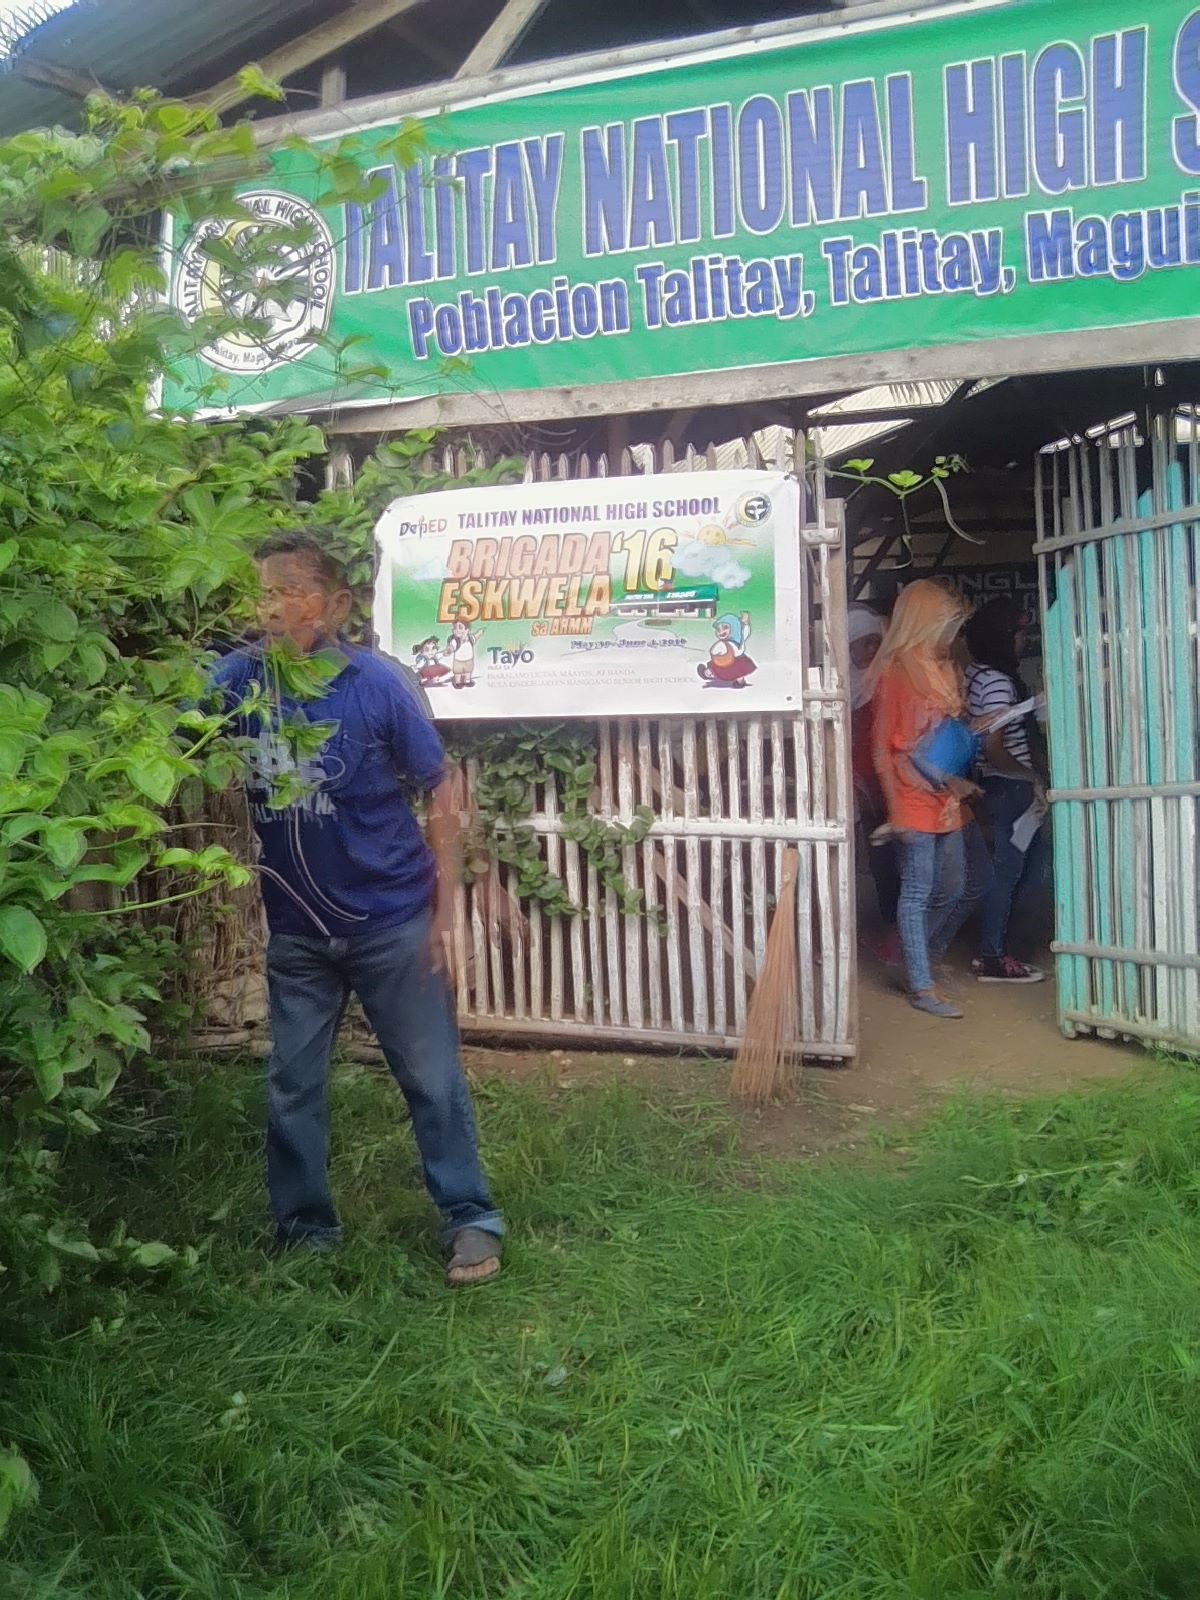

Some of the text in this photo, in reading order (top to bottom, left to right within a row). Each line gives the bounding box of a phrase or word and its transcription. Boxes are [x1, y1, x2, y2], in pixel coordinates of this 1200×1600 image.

[579, 71, 928, 259] NATIONAL
[944, 24, 1149, 206] HIGH
[406, 275, 632, 361] Poblacion
[635, 253, 815, 330] Talitay,
[822, 227, 1017, 307] Talitay,
[457, 509, 518, 530] TALITAY
[522, 504, 601, 526] NATIONAL
[606, 501, 648, 521] HIGH
[652, 496, 721, 518] SCHOOL
[446, 531, 612, 580] BRIGADA
[436, 574, 613, 624] ESKWELA
[531, 616, 593, 637] sa ARMM
[486, 646, 535, 669] Tayo
